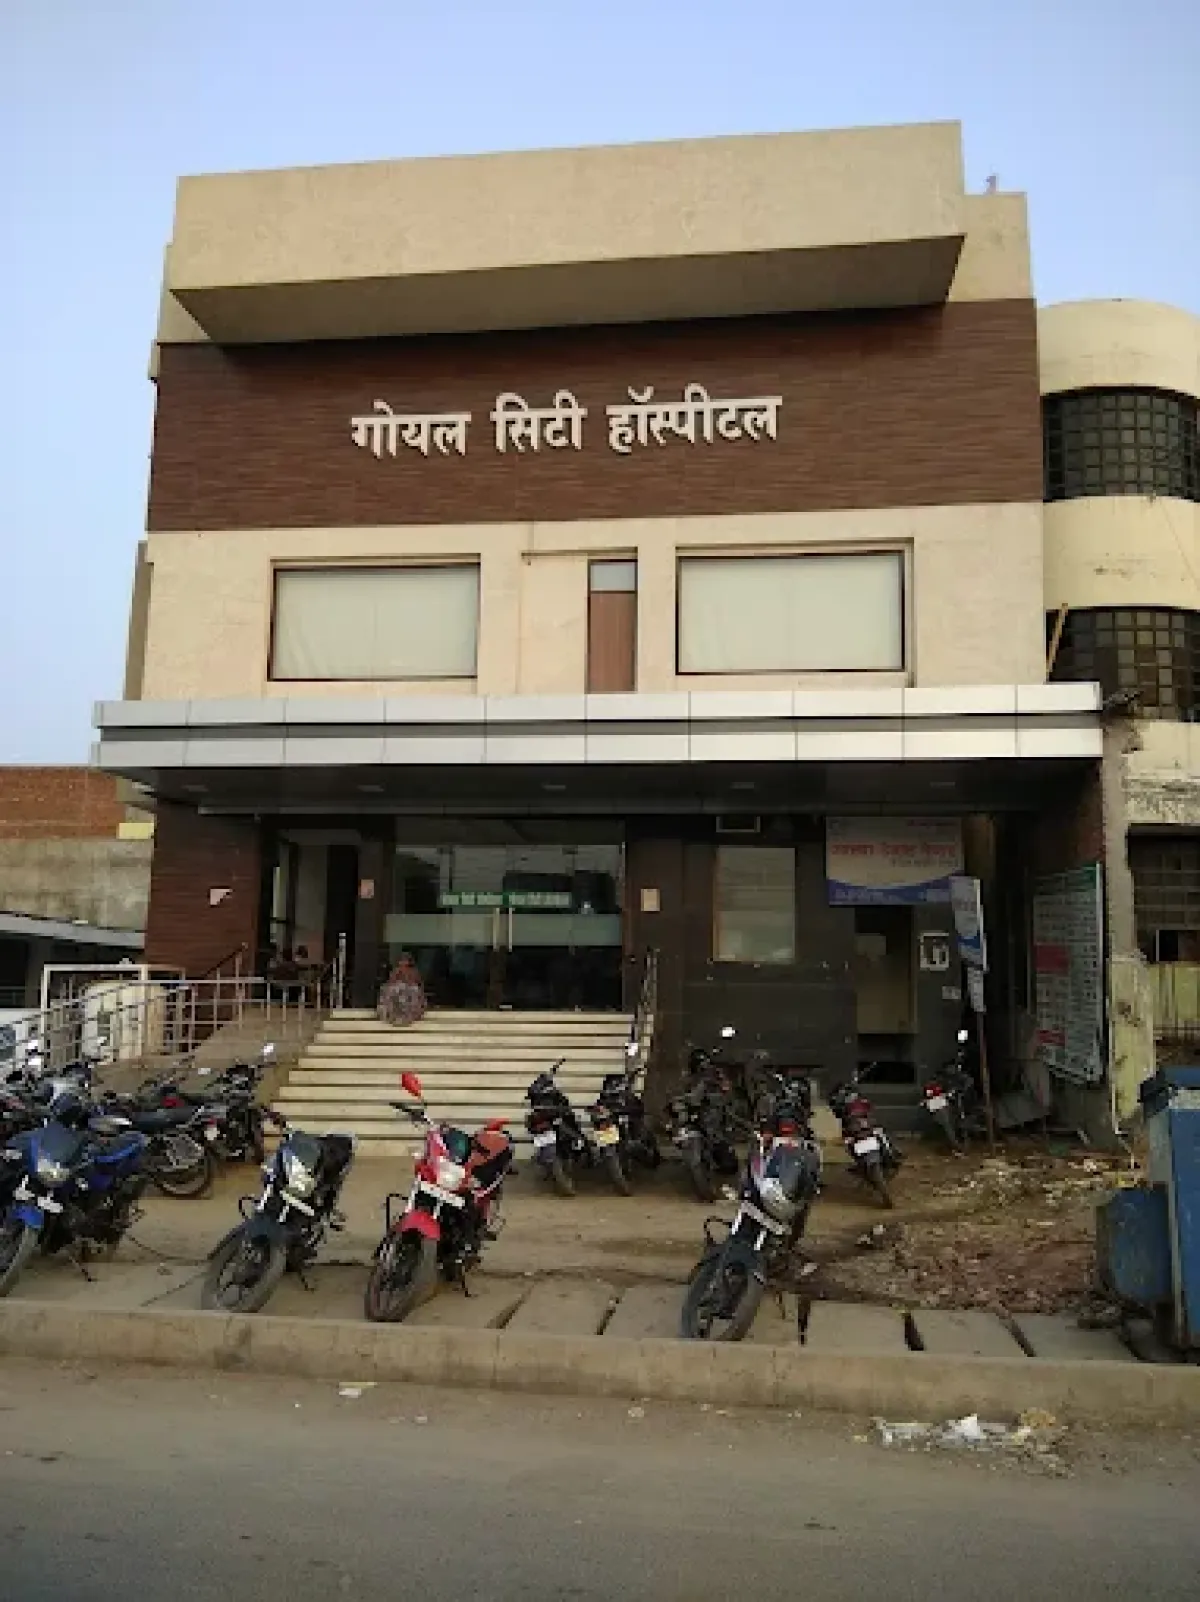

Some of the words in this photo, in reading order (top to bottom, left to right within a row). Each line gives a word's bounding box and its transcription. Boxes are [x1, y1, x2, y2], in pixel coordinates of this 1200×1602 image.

[351, 399, 472, 458] गोयल
[490, 389, 588, 452] सिटी
[606, 383, 783, 454] हॉस्पीटल
